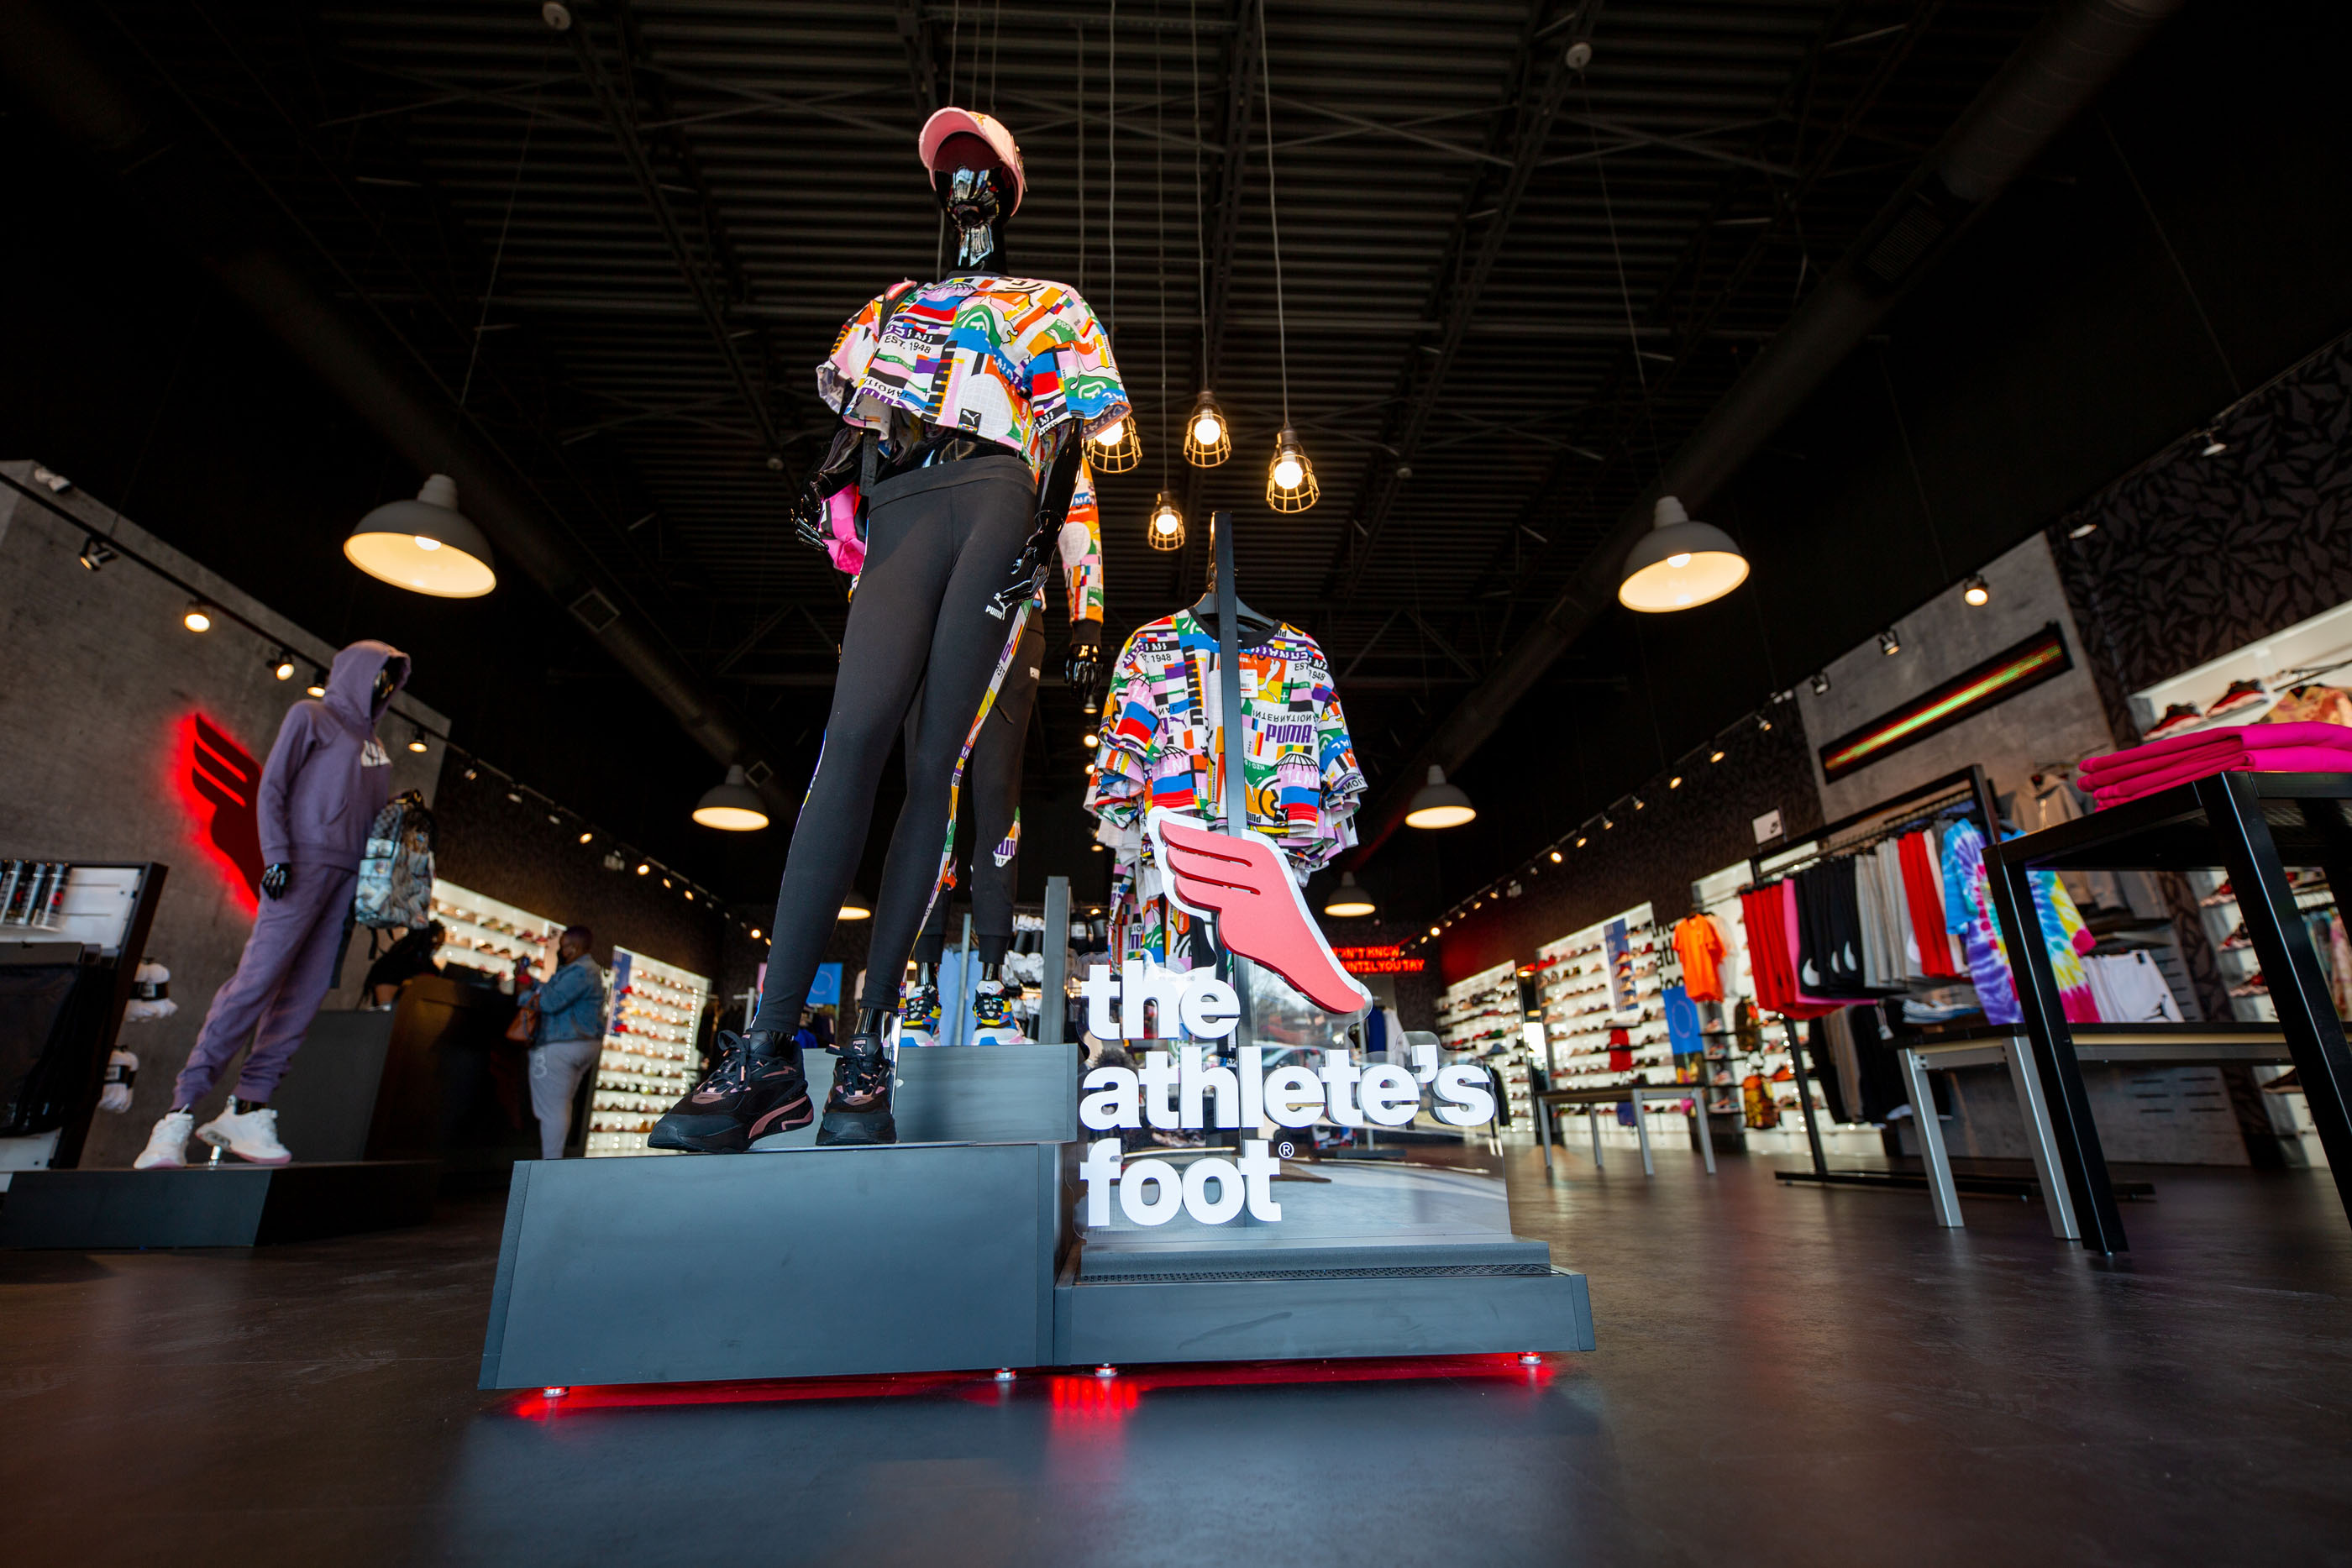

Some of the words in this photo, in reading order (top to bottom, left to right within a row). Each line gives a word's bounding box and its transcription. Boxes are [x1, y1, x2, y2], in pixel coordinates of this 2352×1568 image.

[885, 334, 906, 349] EST.
[910, 341, 931, 354] 1948
[984, 605, 1004, 620] PUMA
[1151, 653, 1172, 663] 1948
[1265, 724, 1312, 743] PUMA
[1366, 946, 1400, 958] KNOW
[1378, 959, 1401, 972] YOU
[1401, 958, 1425, 972] TRY
[1081, 960, 1241, 1041] the
[1079, 1045, 1495, 1131] athlete's
